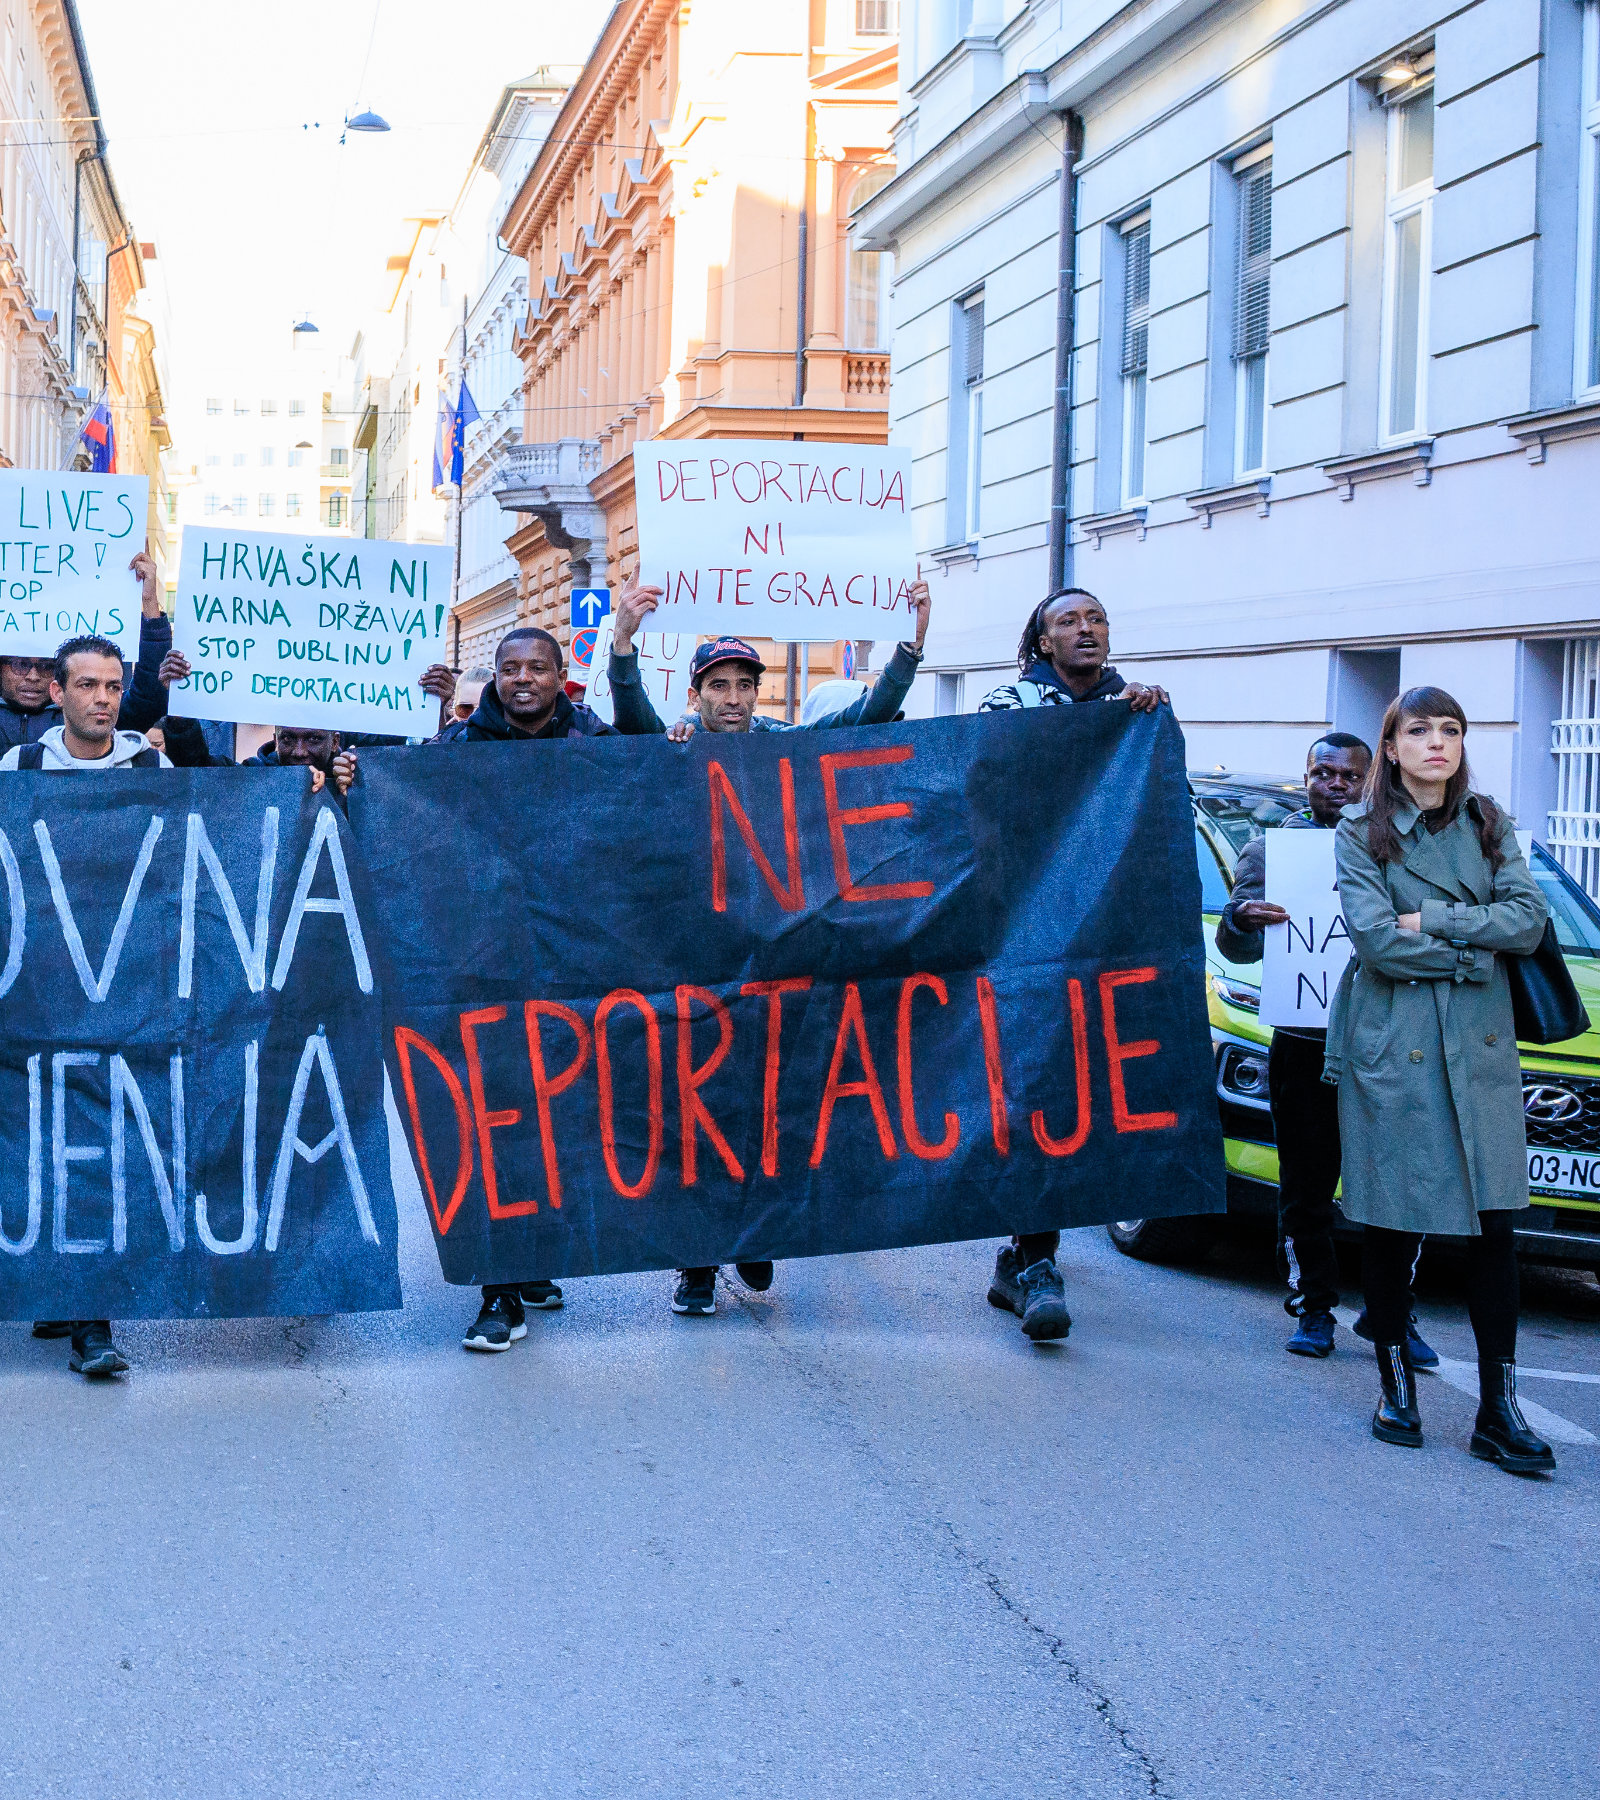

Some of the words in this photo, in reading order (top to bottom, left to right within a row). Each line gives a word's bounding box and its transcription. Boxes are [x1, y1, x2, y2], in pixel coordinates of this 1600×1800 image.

[657, 457, 905, 514] DEPORTACIJA
[19, 486, 135, 539] LIVES
[743, 522, 785, 556] NI
[202, 542, 362, 591] HRVAŠKA
[389, 558, 428, 602] NI
[664, 567, 913, 614] INTEGRACIJA
[193, 594, 291, 628] VARNA
[318, 599, 445, 639] DRŽAVA!
[198, 636, 256, 661] STOP
[707, 744, 937, 913] NE
[394, 966, 1180, 1237] DEPORTACIJE
